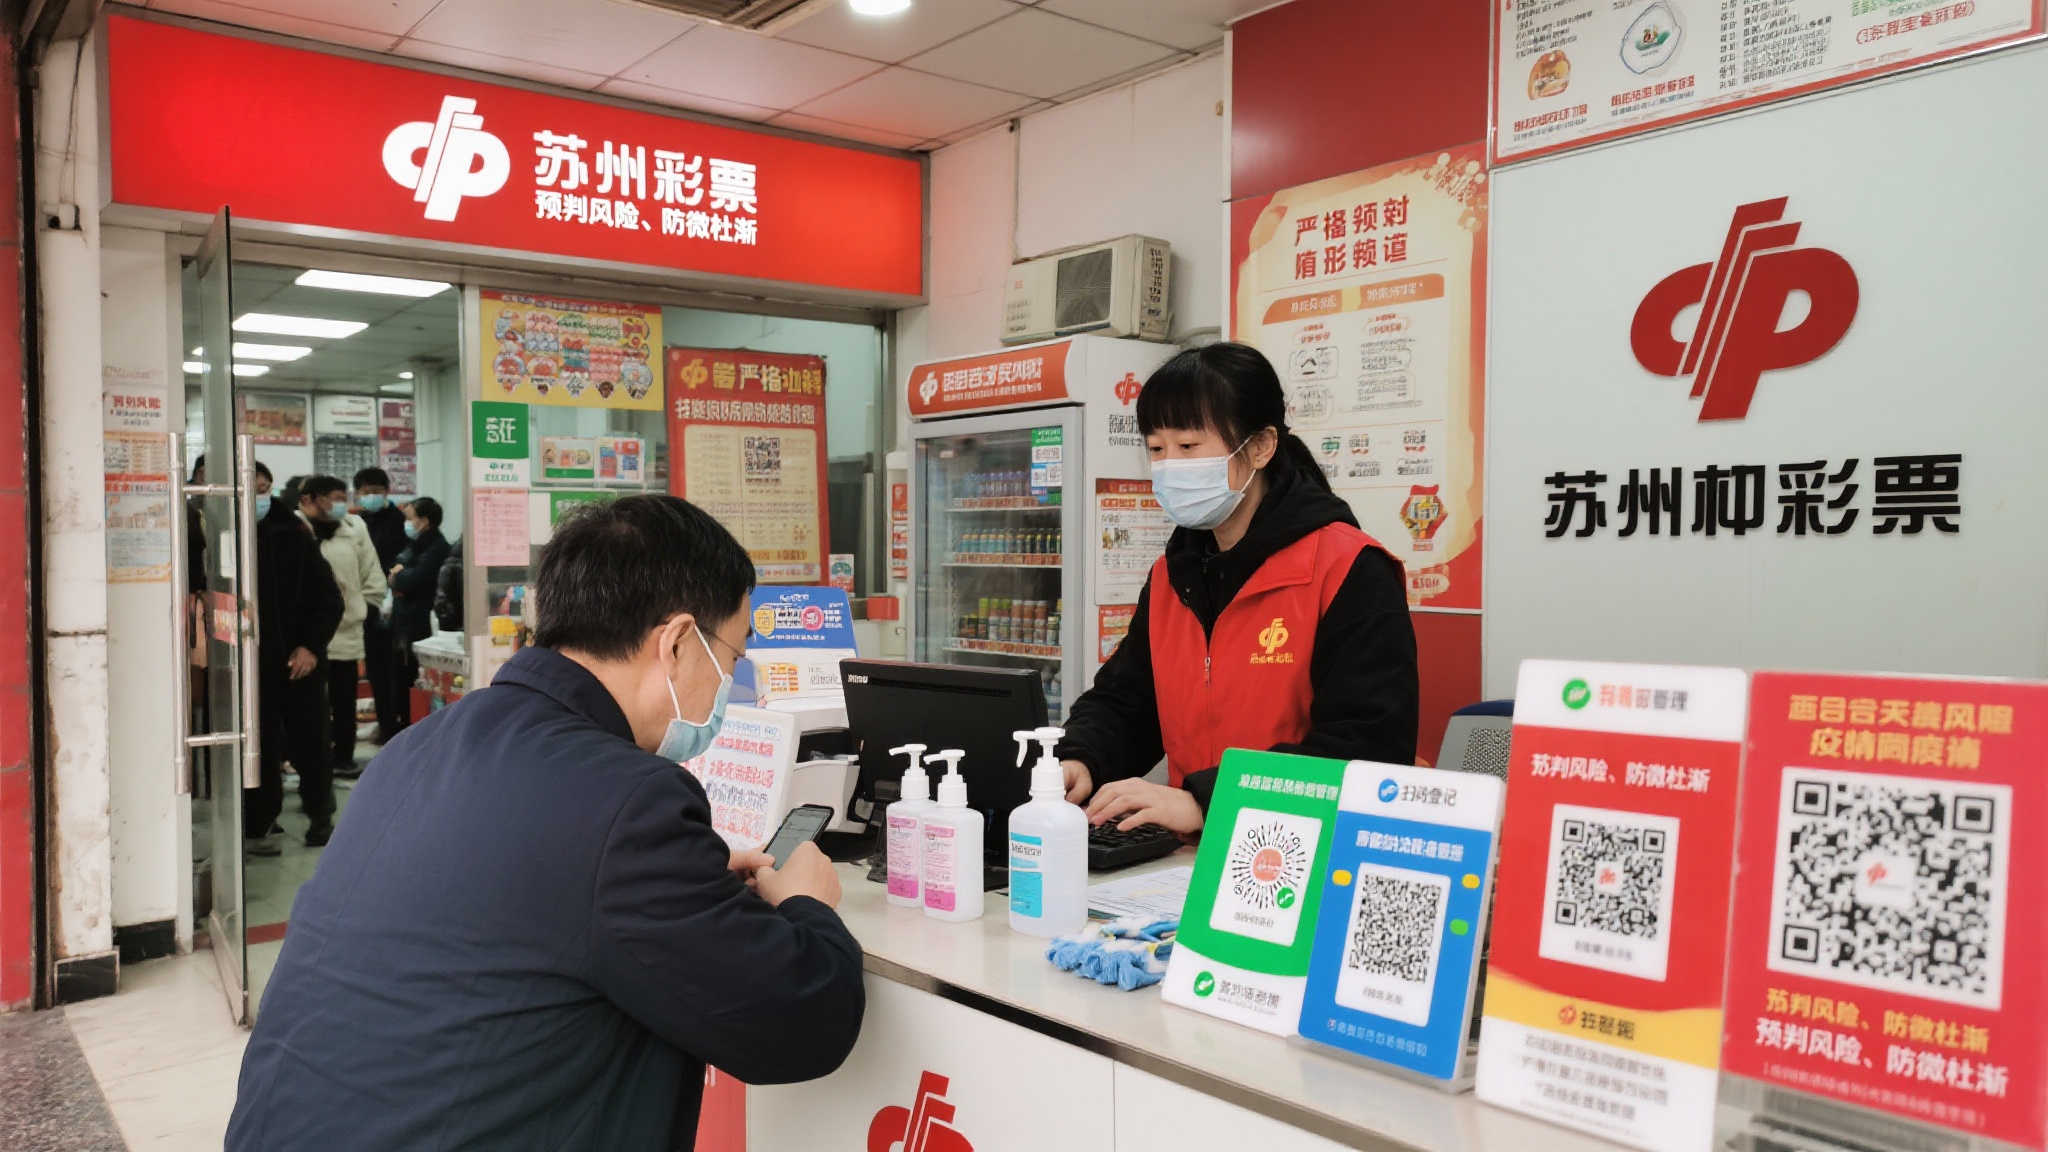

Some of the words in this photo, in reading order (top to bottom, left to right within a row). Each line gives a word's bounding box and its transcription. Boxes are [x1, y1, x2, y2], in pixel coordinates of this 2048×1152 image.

[533, 129, 758, 214] 苏州彩票
[535, 189, 758, 246] 预判风险、防微杜渐
